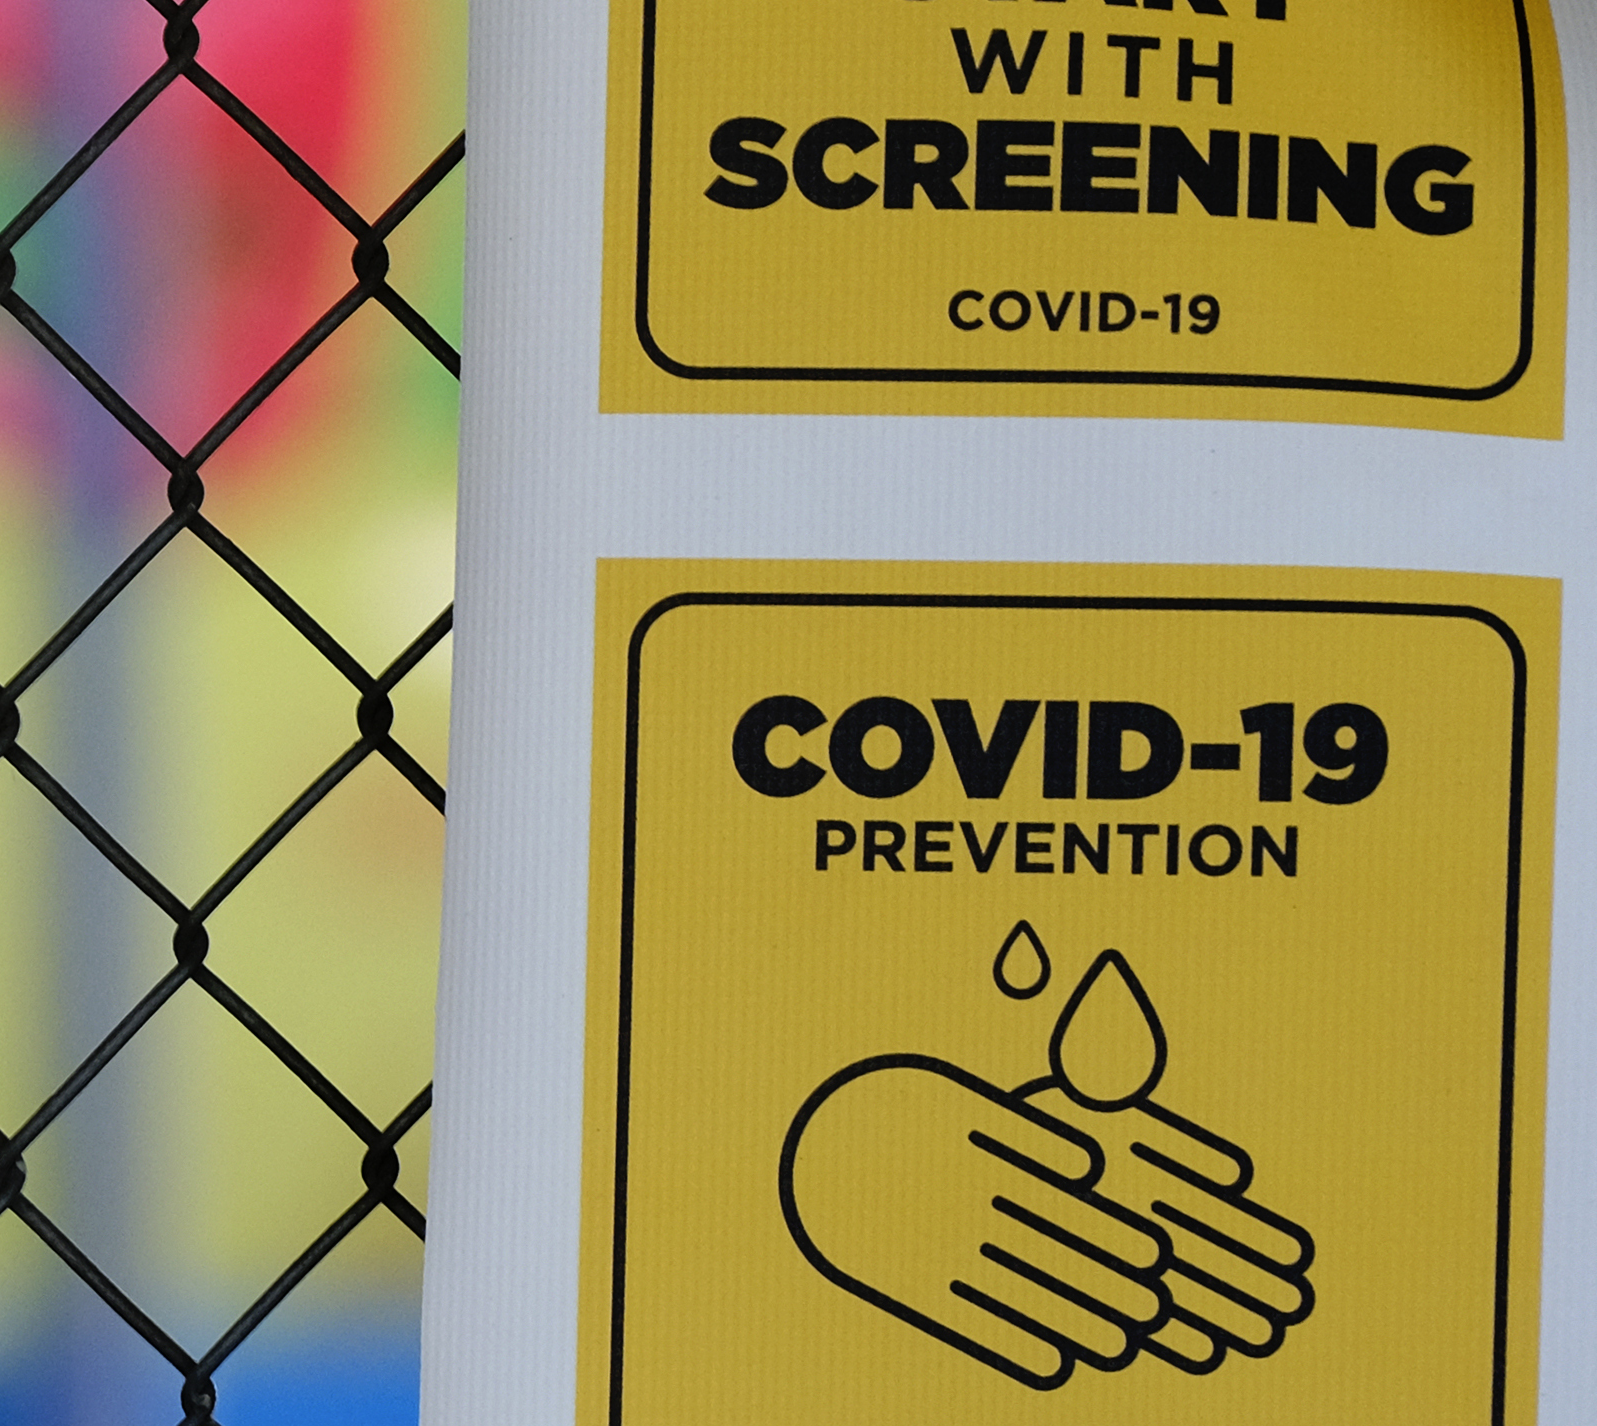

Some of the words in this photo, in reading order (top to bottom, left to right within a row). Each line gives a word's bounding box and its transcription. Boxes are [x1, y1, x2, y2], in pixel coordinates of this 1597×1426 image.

[950, 27, 1234, 105] WITH
[703, 116, 1475, 236] SCREENING
[947, 289, 1220, 335] COVID-19
[731, 694, 1389, 806] COVID-19
[815, 819, 1299, 878] PREVENTION
